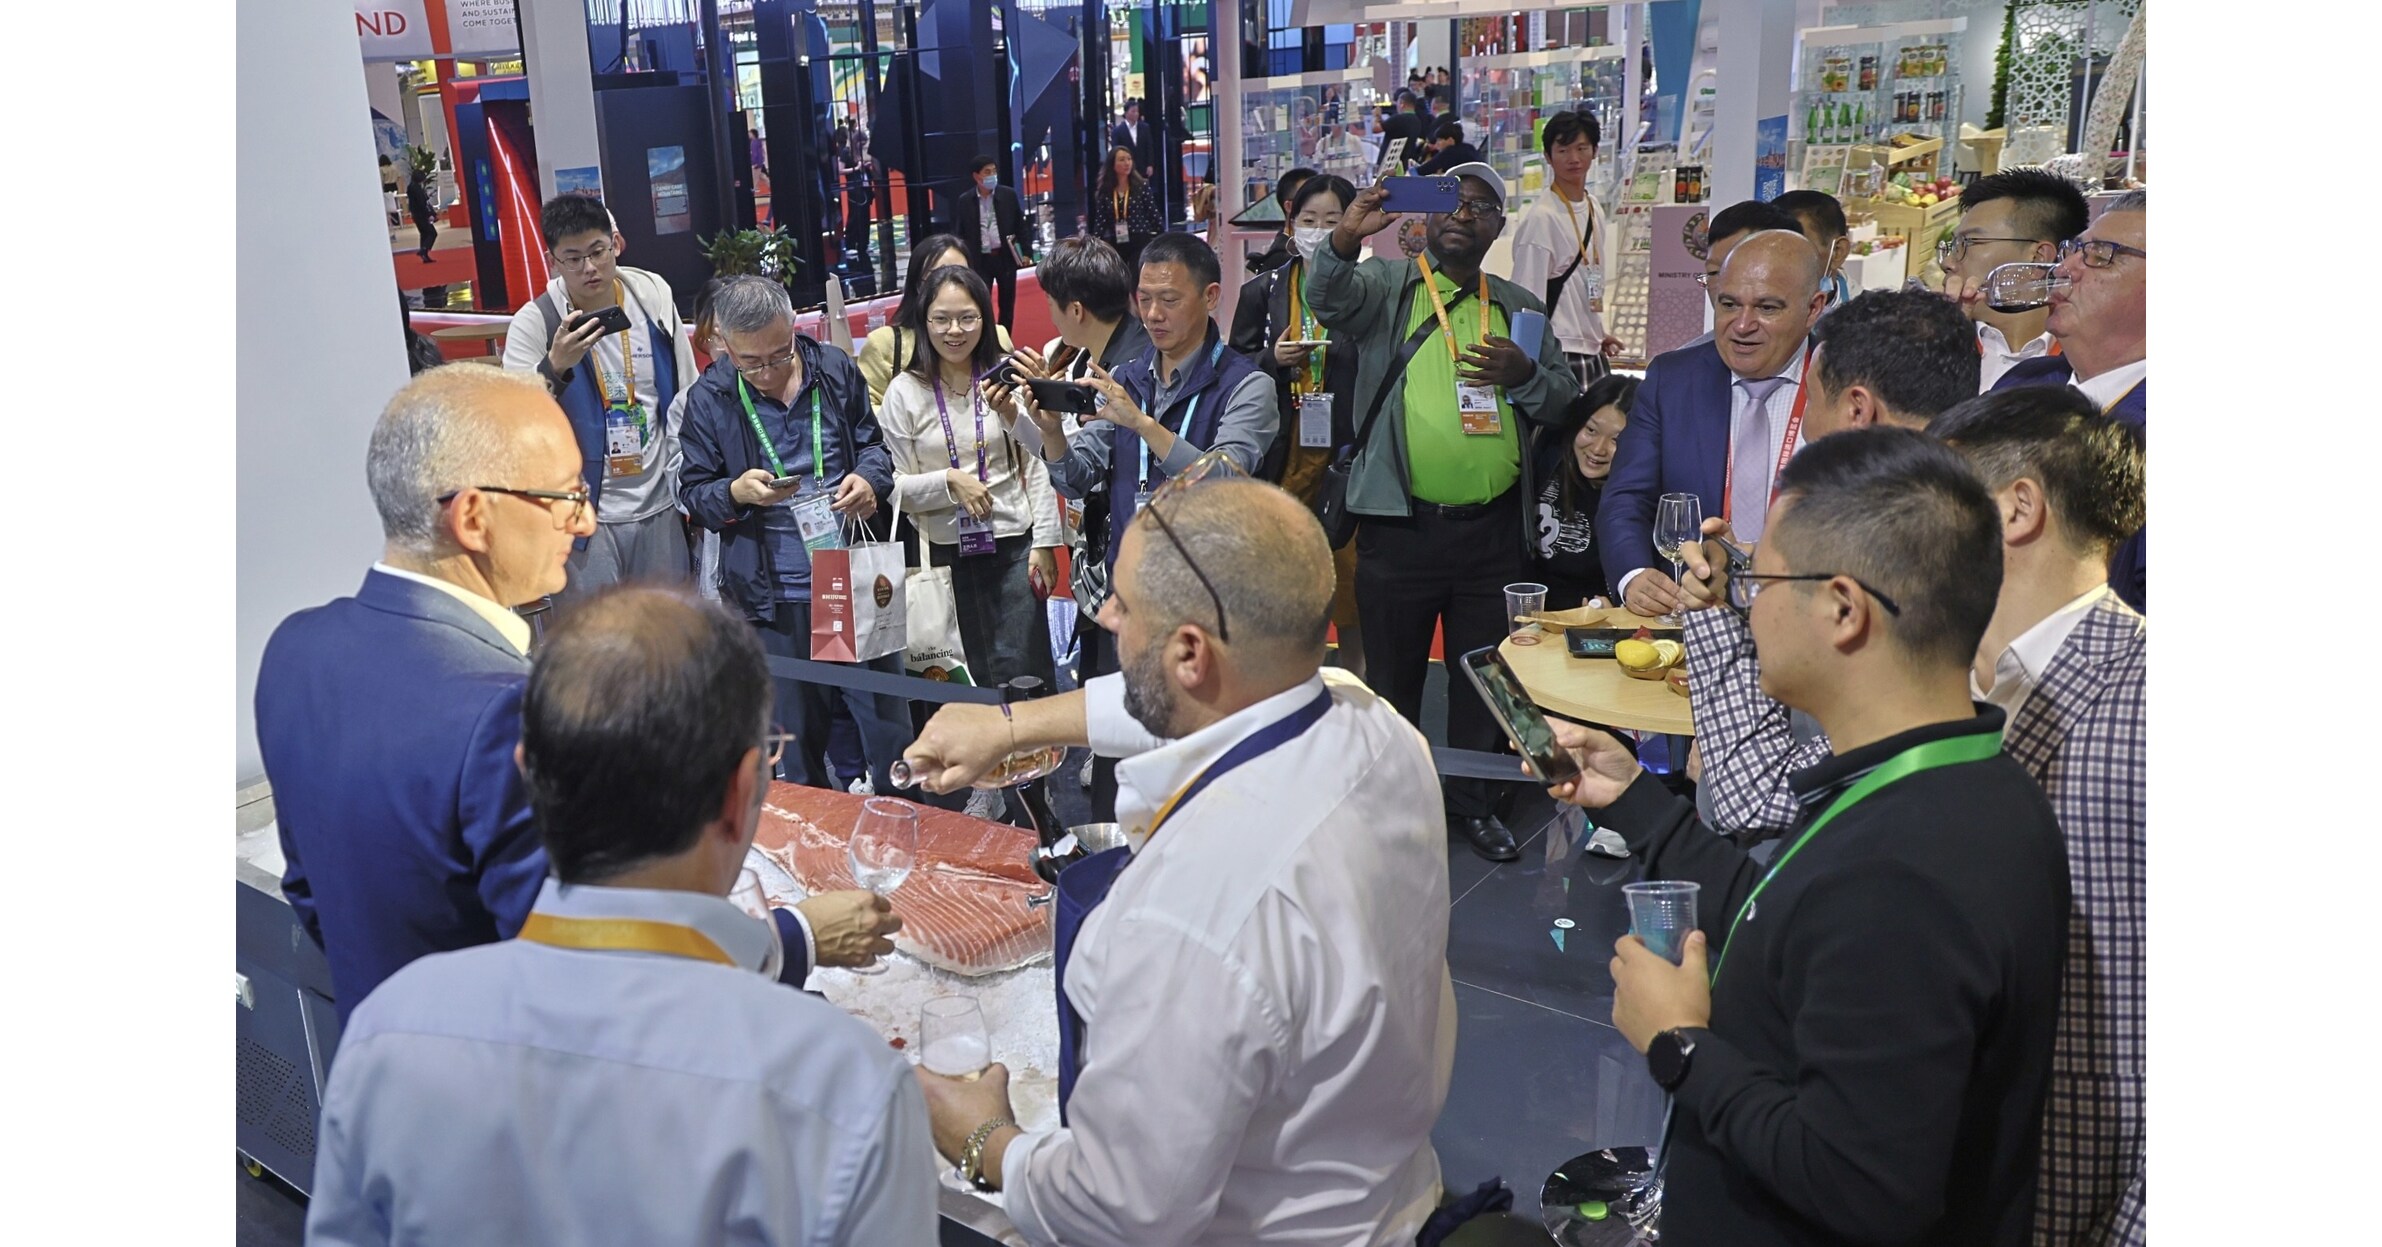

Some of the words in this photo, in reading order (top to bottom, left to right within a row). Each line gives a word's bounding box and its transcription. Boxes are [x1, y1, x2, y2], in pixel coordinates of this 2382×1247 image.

[462, 9, 480, 17] AND
[462, 19, 487, 28] COME
[1658, 271, 1691, 279] MINISTRY
